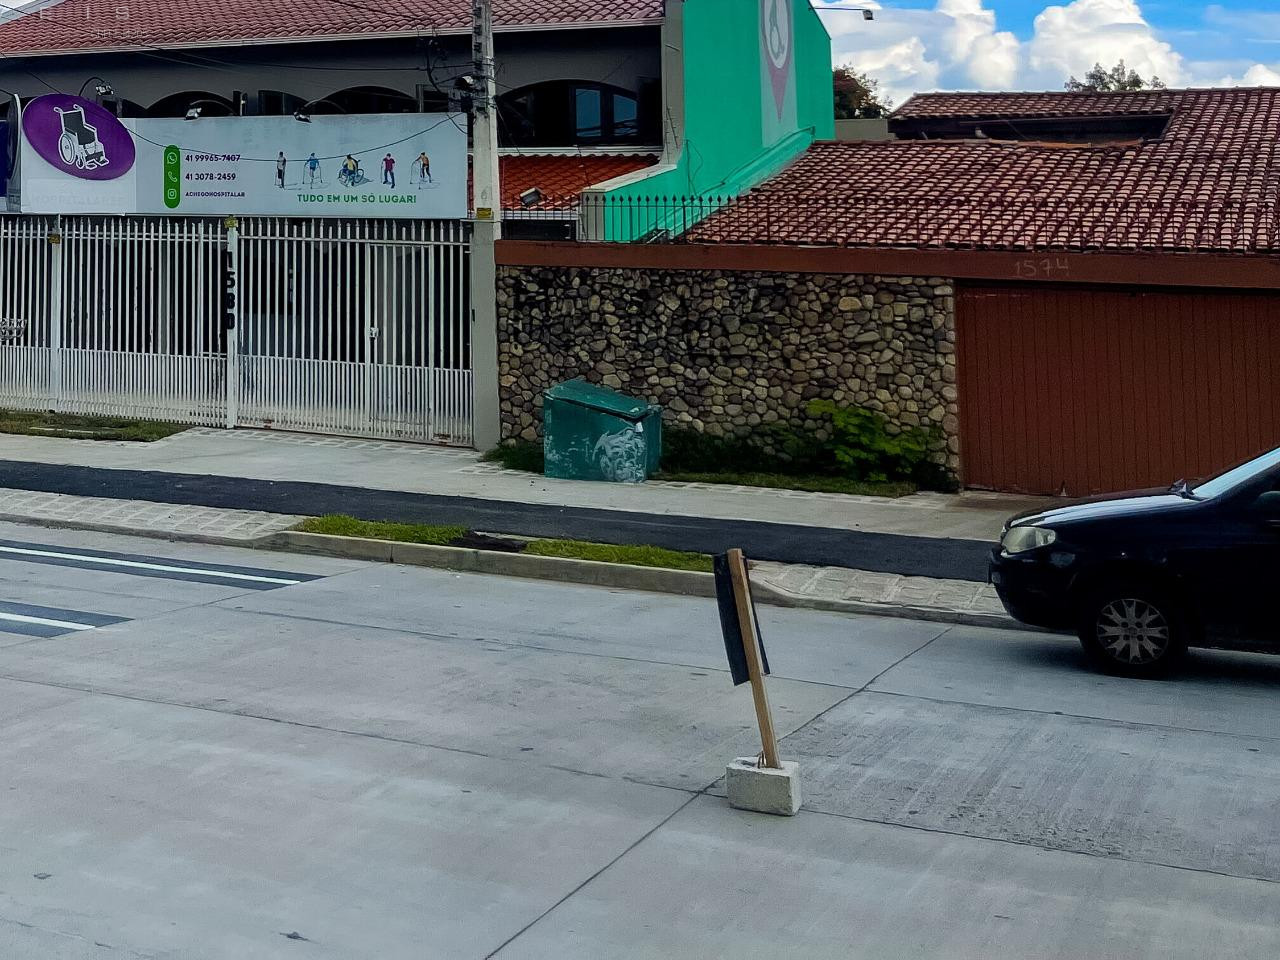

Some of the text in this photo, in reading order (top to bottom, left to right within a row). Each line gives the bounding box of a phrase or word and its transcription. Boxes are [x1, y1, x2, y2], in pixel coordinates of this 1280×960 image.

[185, 154, 193, 162] 41
[297, 194, 324, 202] TUDO
[326, 194, 340, 202] EM
[343, 195, 358, 203] UM
